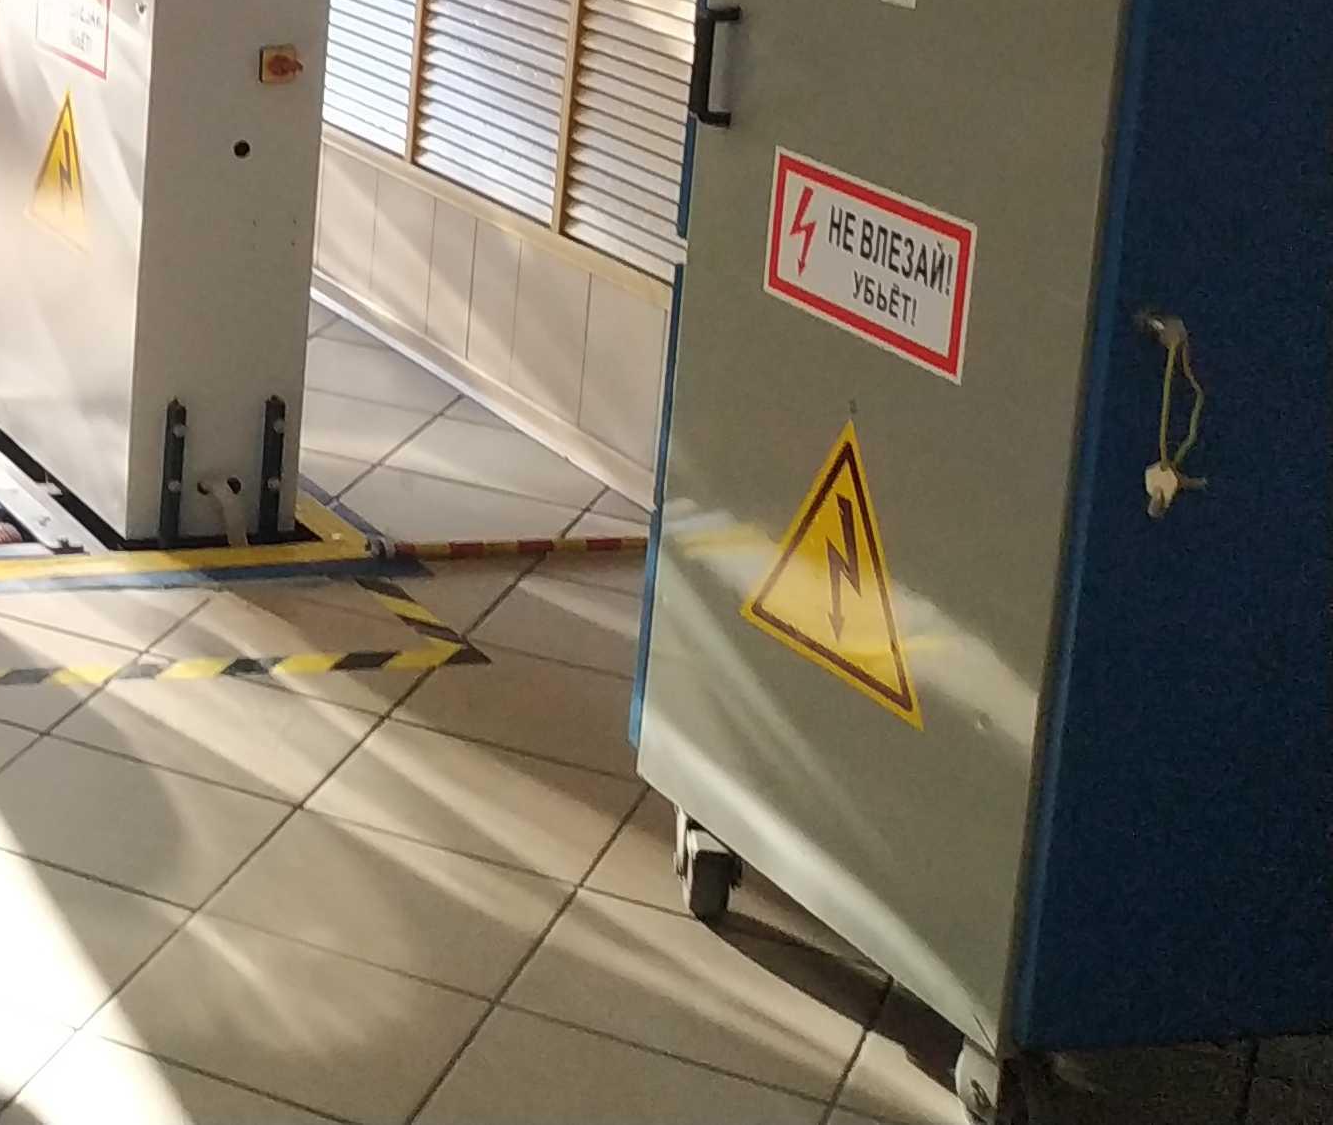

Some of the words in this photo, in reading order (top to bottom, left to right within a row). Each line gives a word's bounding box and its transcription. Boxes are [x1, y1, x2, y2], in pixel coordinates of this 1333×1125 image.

[828, 204, 856, 255] НЕ
[860, 219, 954, 296] ВЛЕЗАЙ!
[852, 270, 918, 326] УБЬЁТ!
